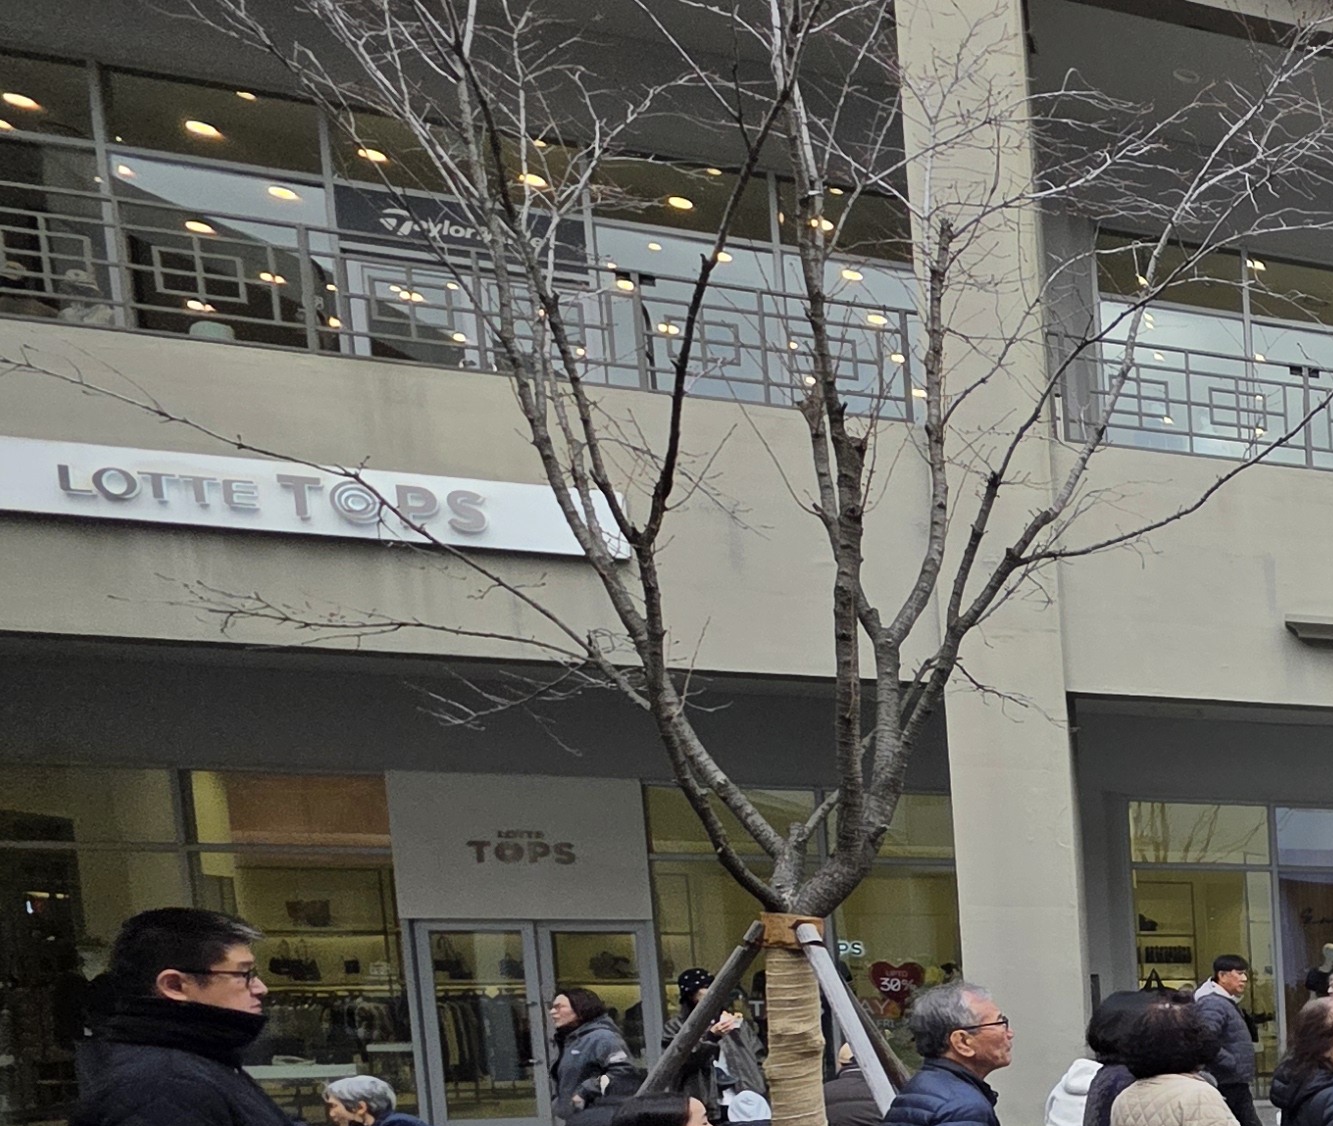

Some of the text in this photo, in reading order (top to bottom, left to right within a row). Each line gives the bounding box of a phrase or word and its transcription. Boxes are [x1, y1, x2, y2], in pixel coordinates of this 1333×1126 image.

[57, 464, 489, 535] LOTTE TOPS
[466, 840, 576, 865] TOPS
